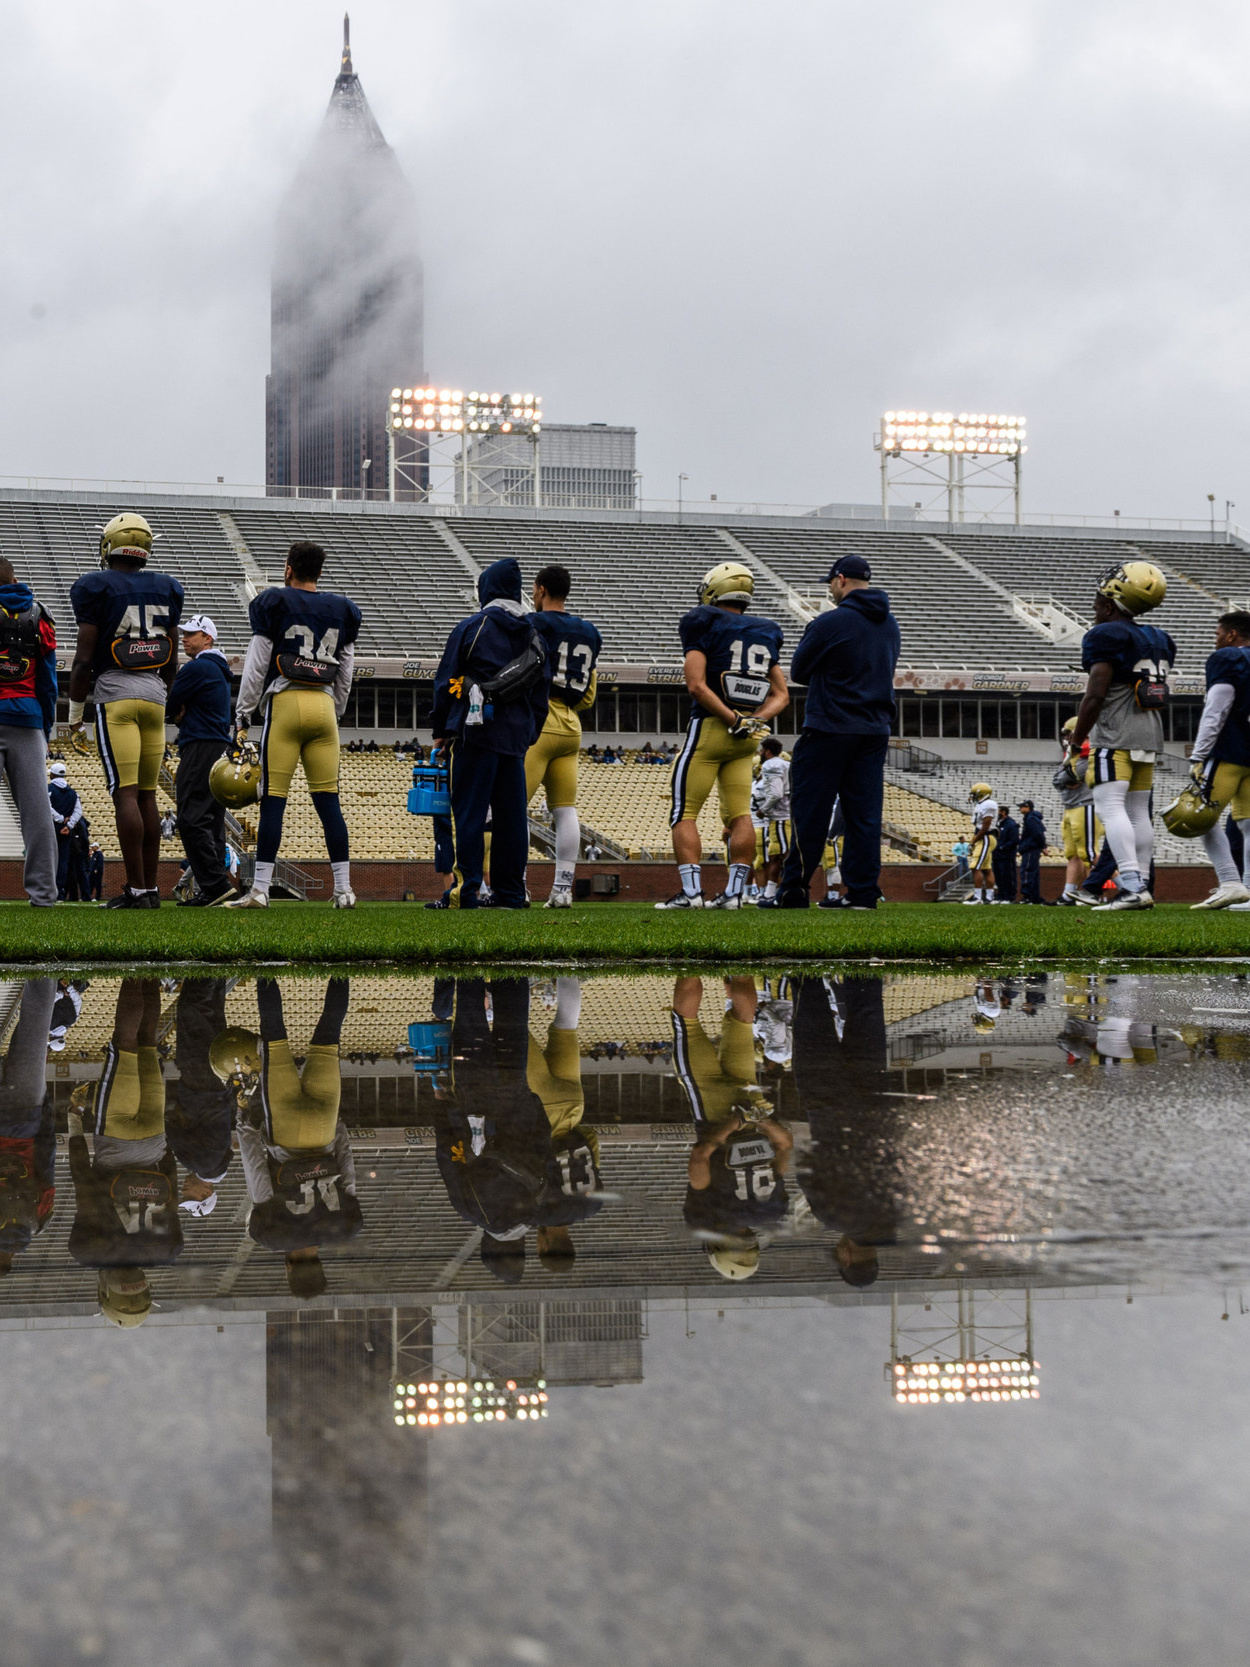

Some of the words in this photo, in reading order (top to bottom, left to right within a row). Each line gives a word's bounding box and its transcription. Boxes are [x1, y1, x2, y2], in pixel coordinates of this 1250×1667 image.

[123, 549, 147, 558] Riddell
[115, 605, 170, 638] 45
[129, 643, 160, 654] POWER
[285, 625, 340, 665] 34
[295, 657, 327, 671] POWER
[552, 641, 592, 691] 13
[734, 682, 762, 696] DOUGLAS
[973, 681, 1029, 690] GARDNER
[1051, 682, 1085, 691] DODD
